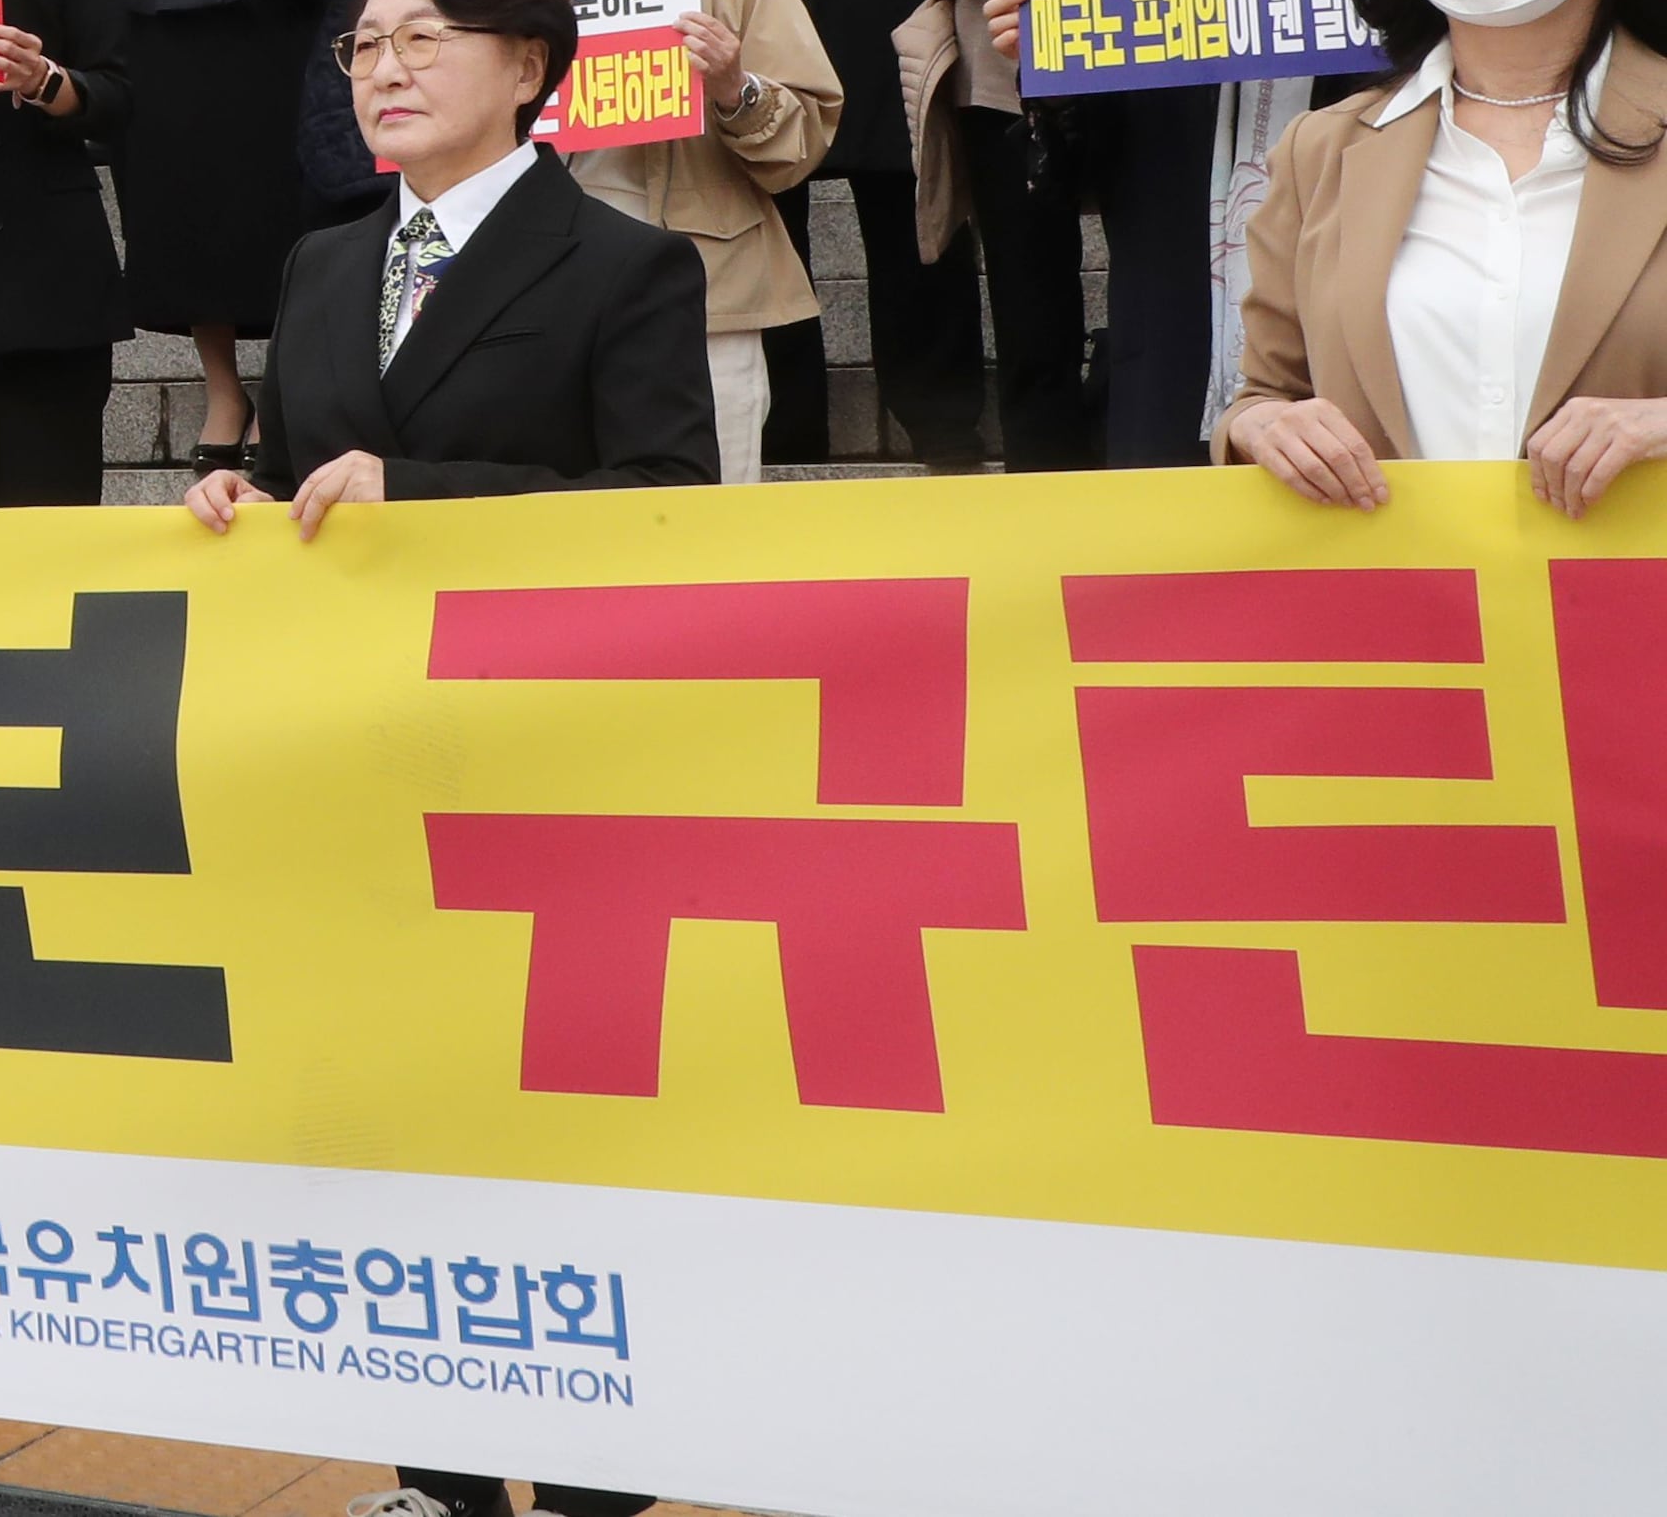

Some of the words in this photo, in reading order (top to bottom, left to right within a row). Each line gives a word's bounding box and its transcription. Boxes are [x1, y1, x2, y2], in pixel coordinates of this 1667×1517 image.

[568, 44, 692, 131] 사퇴하라!
[10, 1309, 325, 1372] KINDERGARTEN
[337, 1344, 634, 1406] ASSOCIATION
